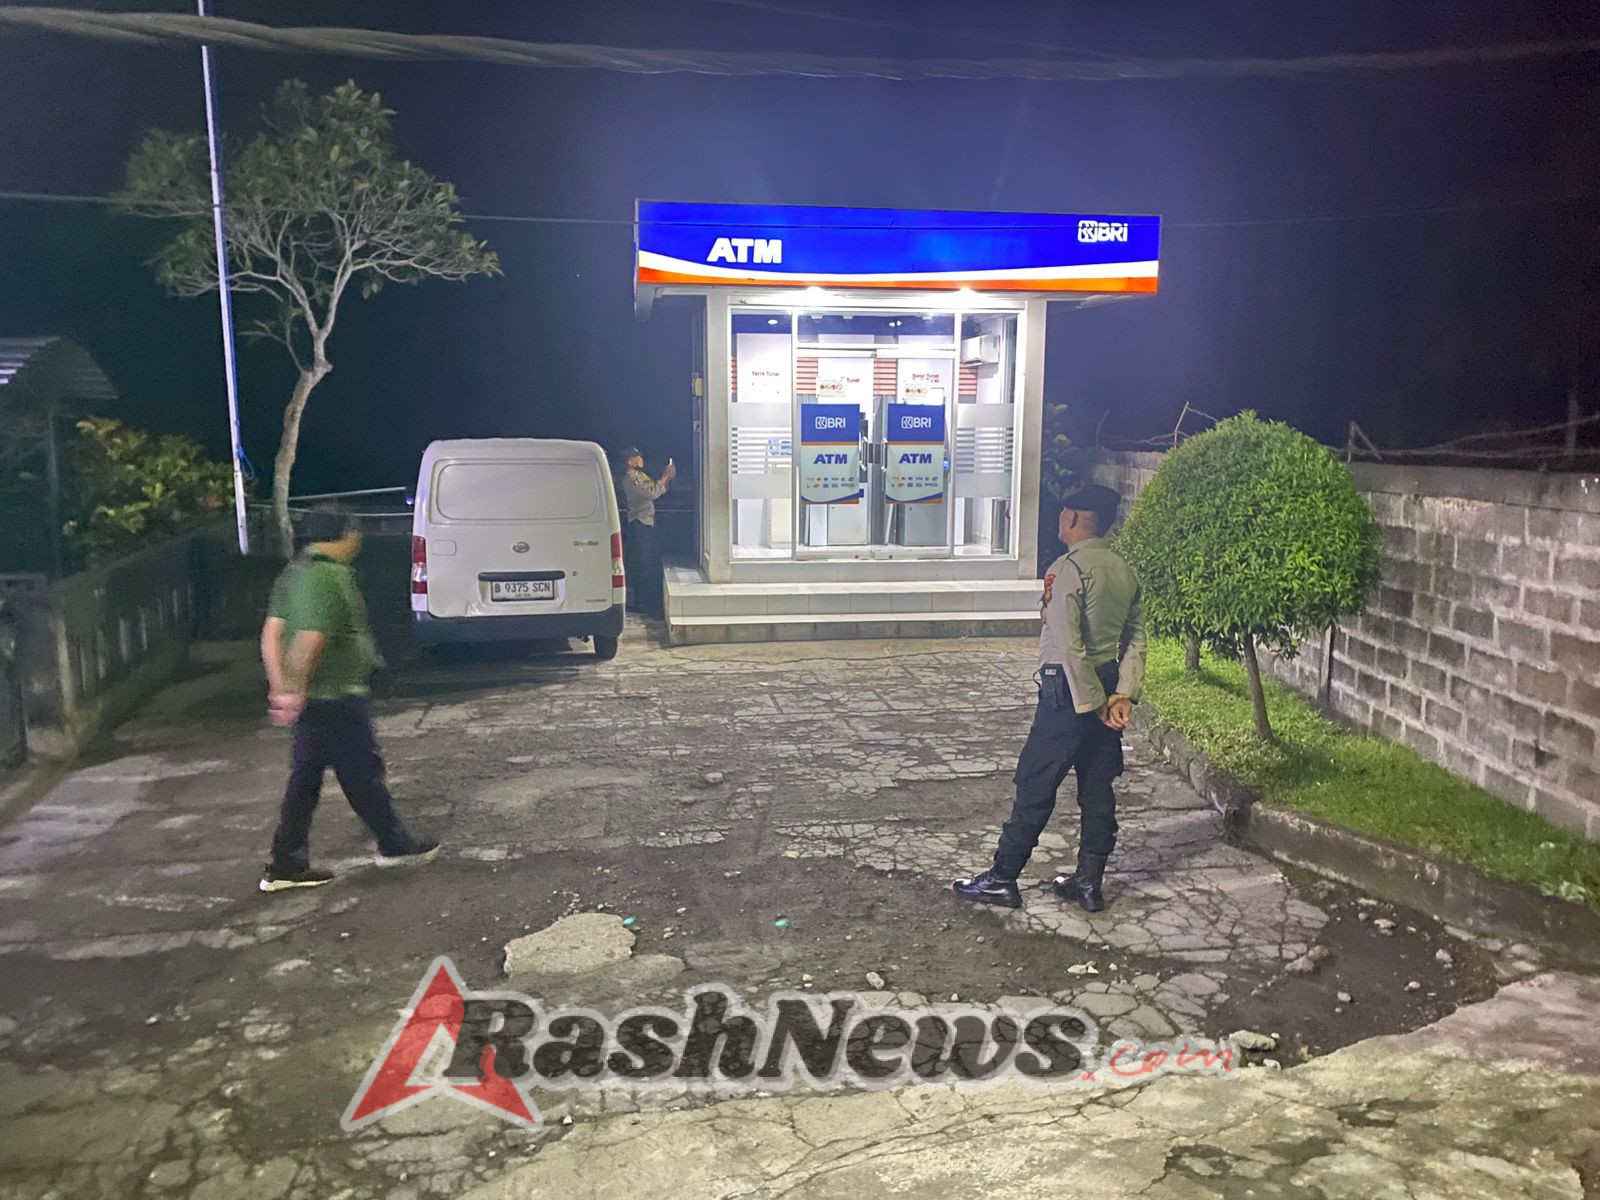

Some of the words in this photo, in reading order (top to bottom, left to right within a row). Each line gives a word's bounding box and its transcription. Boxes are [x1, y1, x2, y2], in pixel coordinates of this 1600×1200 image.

[1098, 222, 1128, 242] BRI
[706, 237, 782, 263] ATM
[827, 417, 846, 429] BRI
[913, 417, 932, 429] BRI
[813, 453, 848, 465] ATM
[898, 453, 932, 464] ATM
[494, 583, 501, 593] B
[504, 582, 529, 593] 9375
[532, 582, 551, 593] SCN
